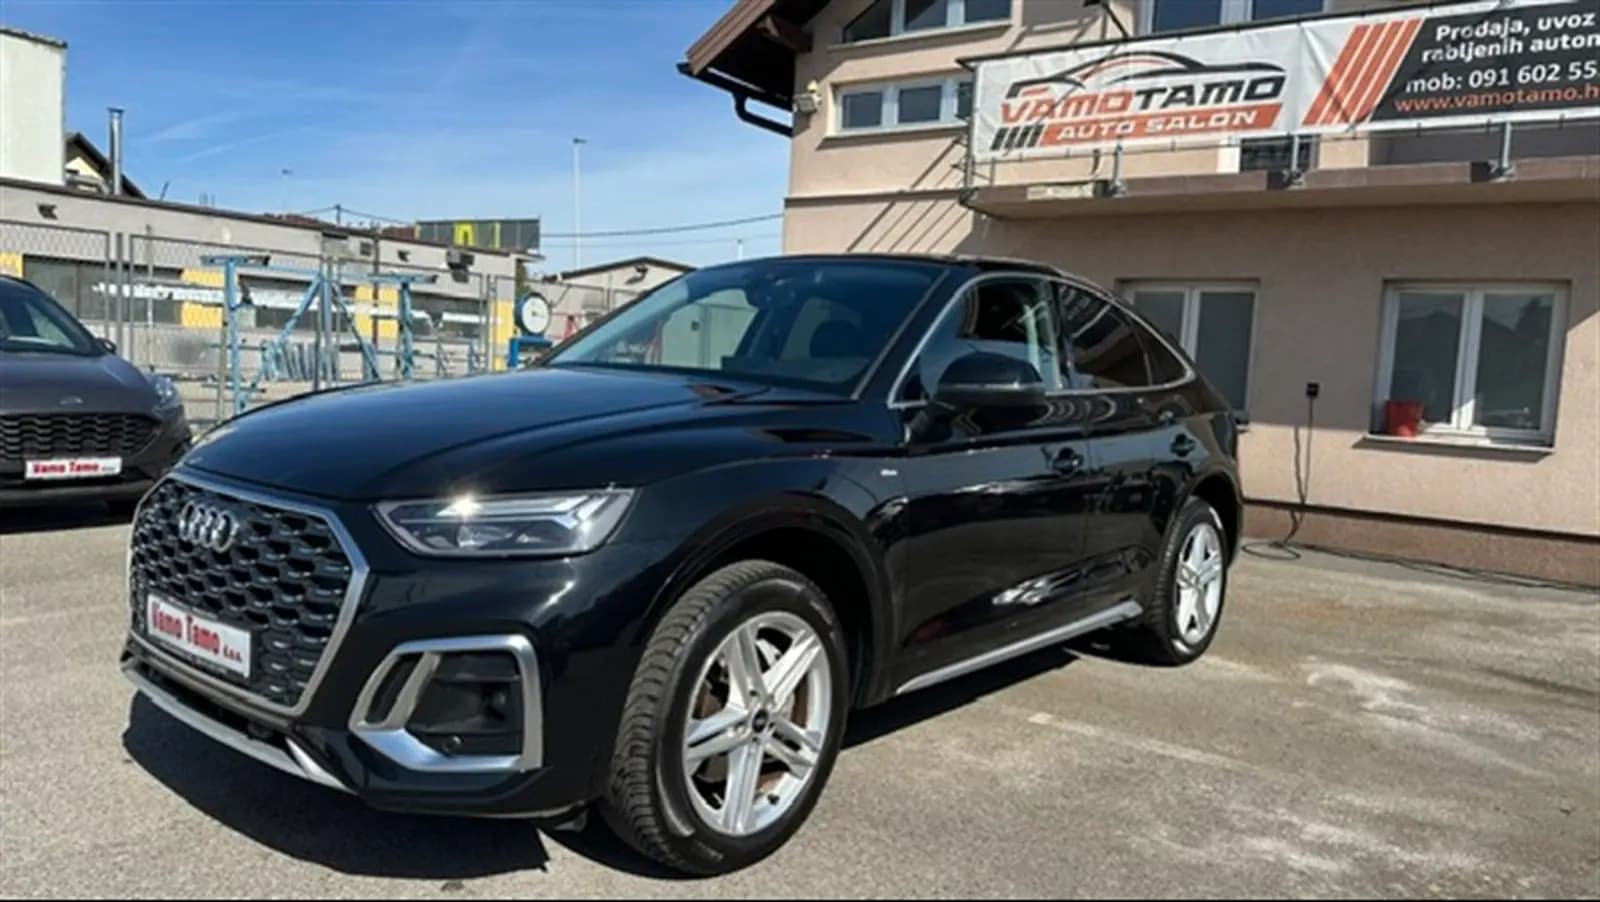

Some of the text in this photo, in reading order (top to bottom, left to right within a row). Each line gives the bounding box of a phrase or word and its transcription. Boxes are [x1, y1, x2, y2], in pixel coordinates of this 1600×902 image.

[1436, 13, 1596, 41] Prodaja, uvoz
[1422, 36, 1523, 63] rabljenih
[1405, 60, 1598, 93] mob: 091 602 55
[1055, 111, 1257, 141] AUTO SALON
[185, 614, 221, 656] Tamo
